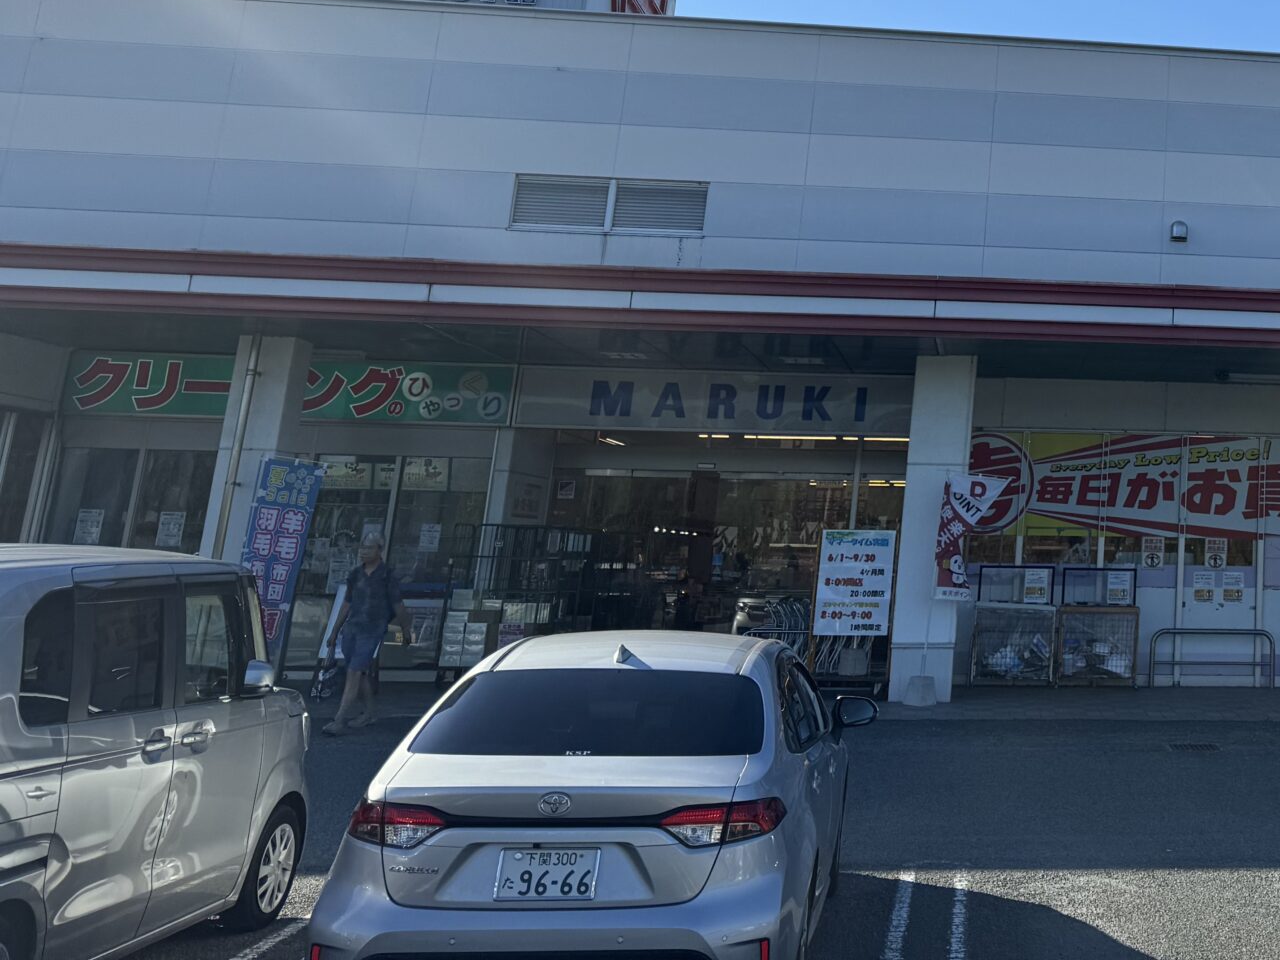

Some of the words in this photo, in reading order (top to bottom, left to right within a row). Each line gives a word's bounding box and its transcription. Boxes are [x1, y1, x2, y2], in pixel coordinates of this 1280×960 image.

[589, 380, 868, 422] MARUKI
[1050, 456, 1130, 473] Everyday
[1134, 453, 1181, 467] Low
[1188, 440, 1271, 464] Price!
[267, 509, 306, 602] 羊毛布団
[518, 869, 592, 896] 96-66
